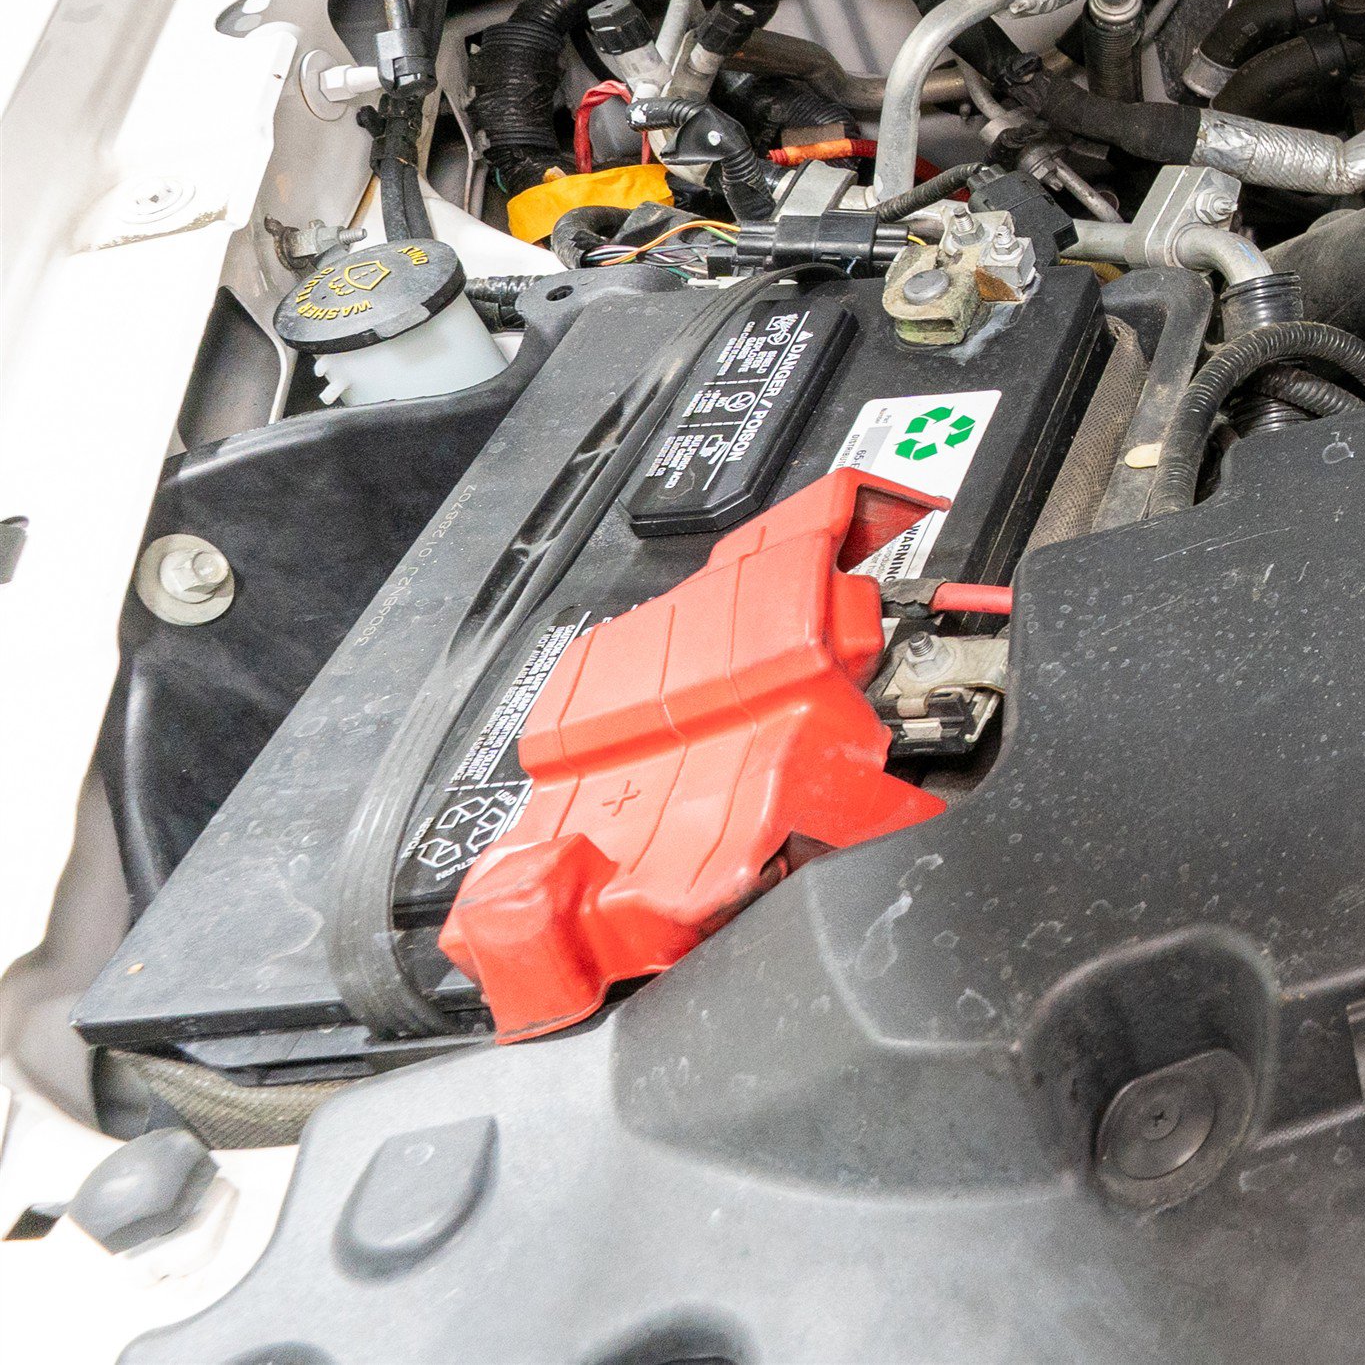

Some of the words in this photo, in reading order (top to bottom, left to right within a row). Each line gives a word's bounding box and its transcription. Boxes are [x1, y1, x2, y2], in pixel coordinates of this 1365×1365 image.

[398, 245, 429, 266] ONLY
[295, 266, 335, 304] FLUID
[297, 300, 373, 321] WASHER
[764, 343, 808, 397] DANGER
[725, 409, 769, 462] POISON
[495, 789, 518, 806] LEAD
